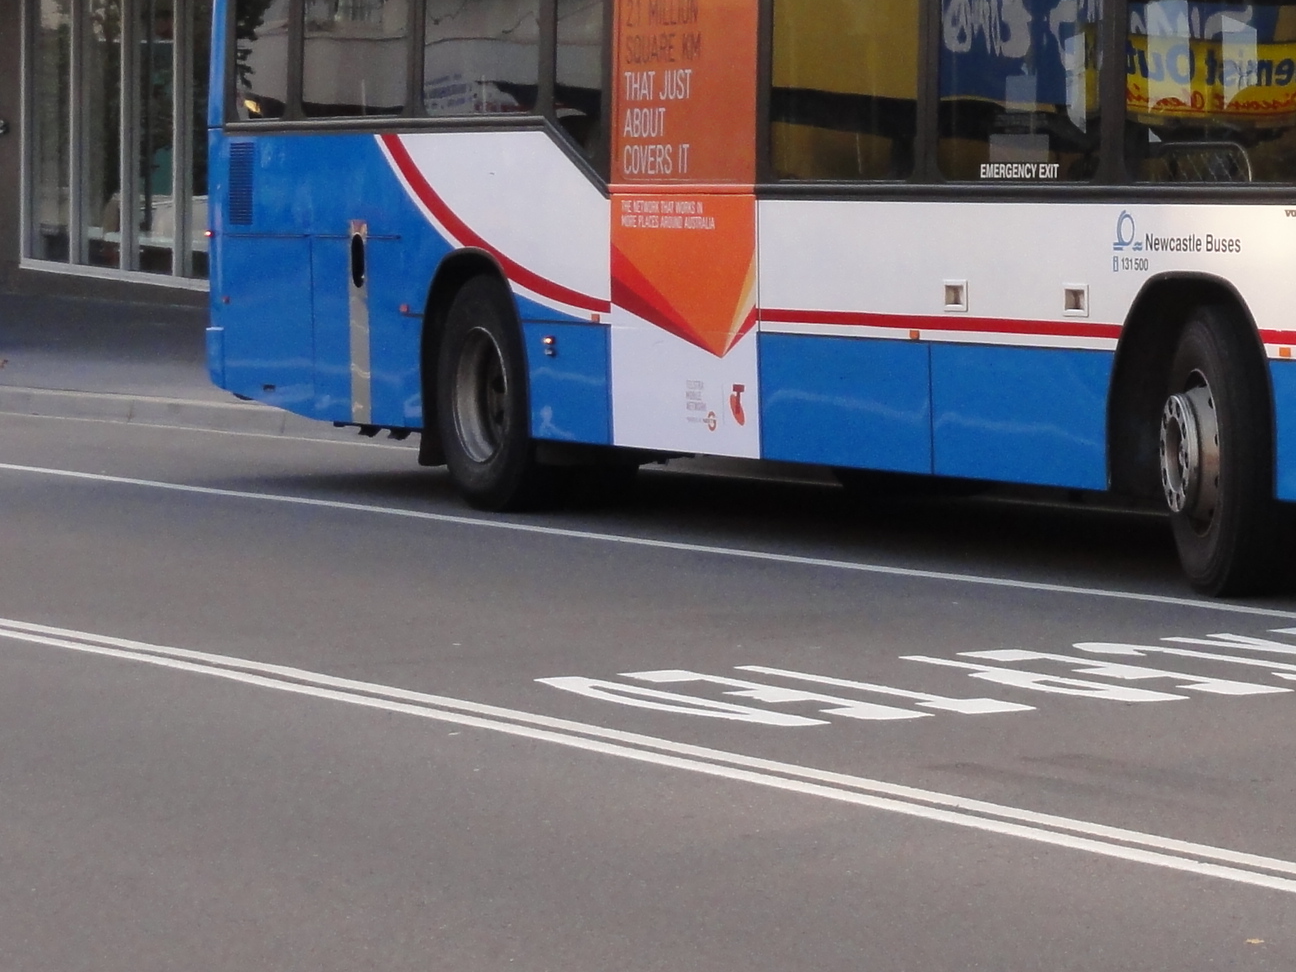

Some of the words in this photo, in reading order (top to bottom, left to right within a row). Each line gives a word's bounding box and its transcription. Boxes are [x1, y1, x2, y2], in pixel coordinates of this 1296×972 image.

[626, 32, 676, 65] SQUARE
[624, 71, 656, 101] THAT
[659, 69, 692, 100] JUST
[623, 107, 666, 138] ABOUT
[623, 144, 673, 175] COVERS
[678, 143, 690, 174] IT
[980, 163, 1037, 178] EMERGENCY
[1039, 163, 1060, 178] EXIT
[684, 216, 715, 230] AUSTRALIA
[1145, 233, 1202, 252] Newcastle
[1205, 234, 1241, 253] Buses
